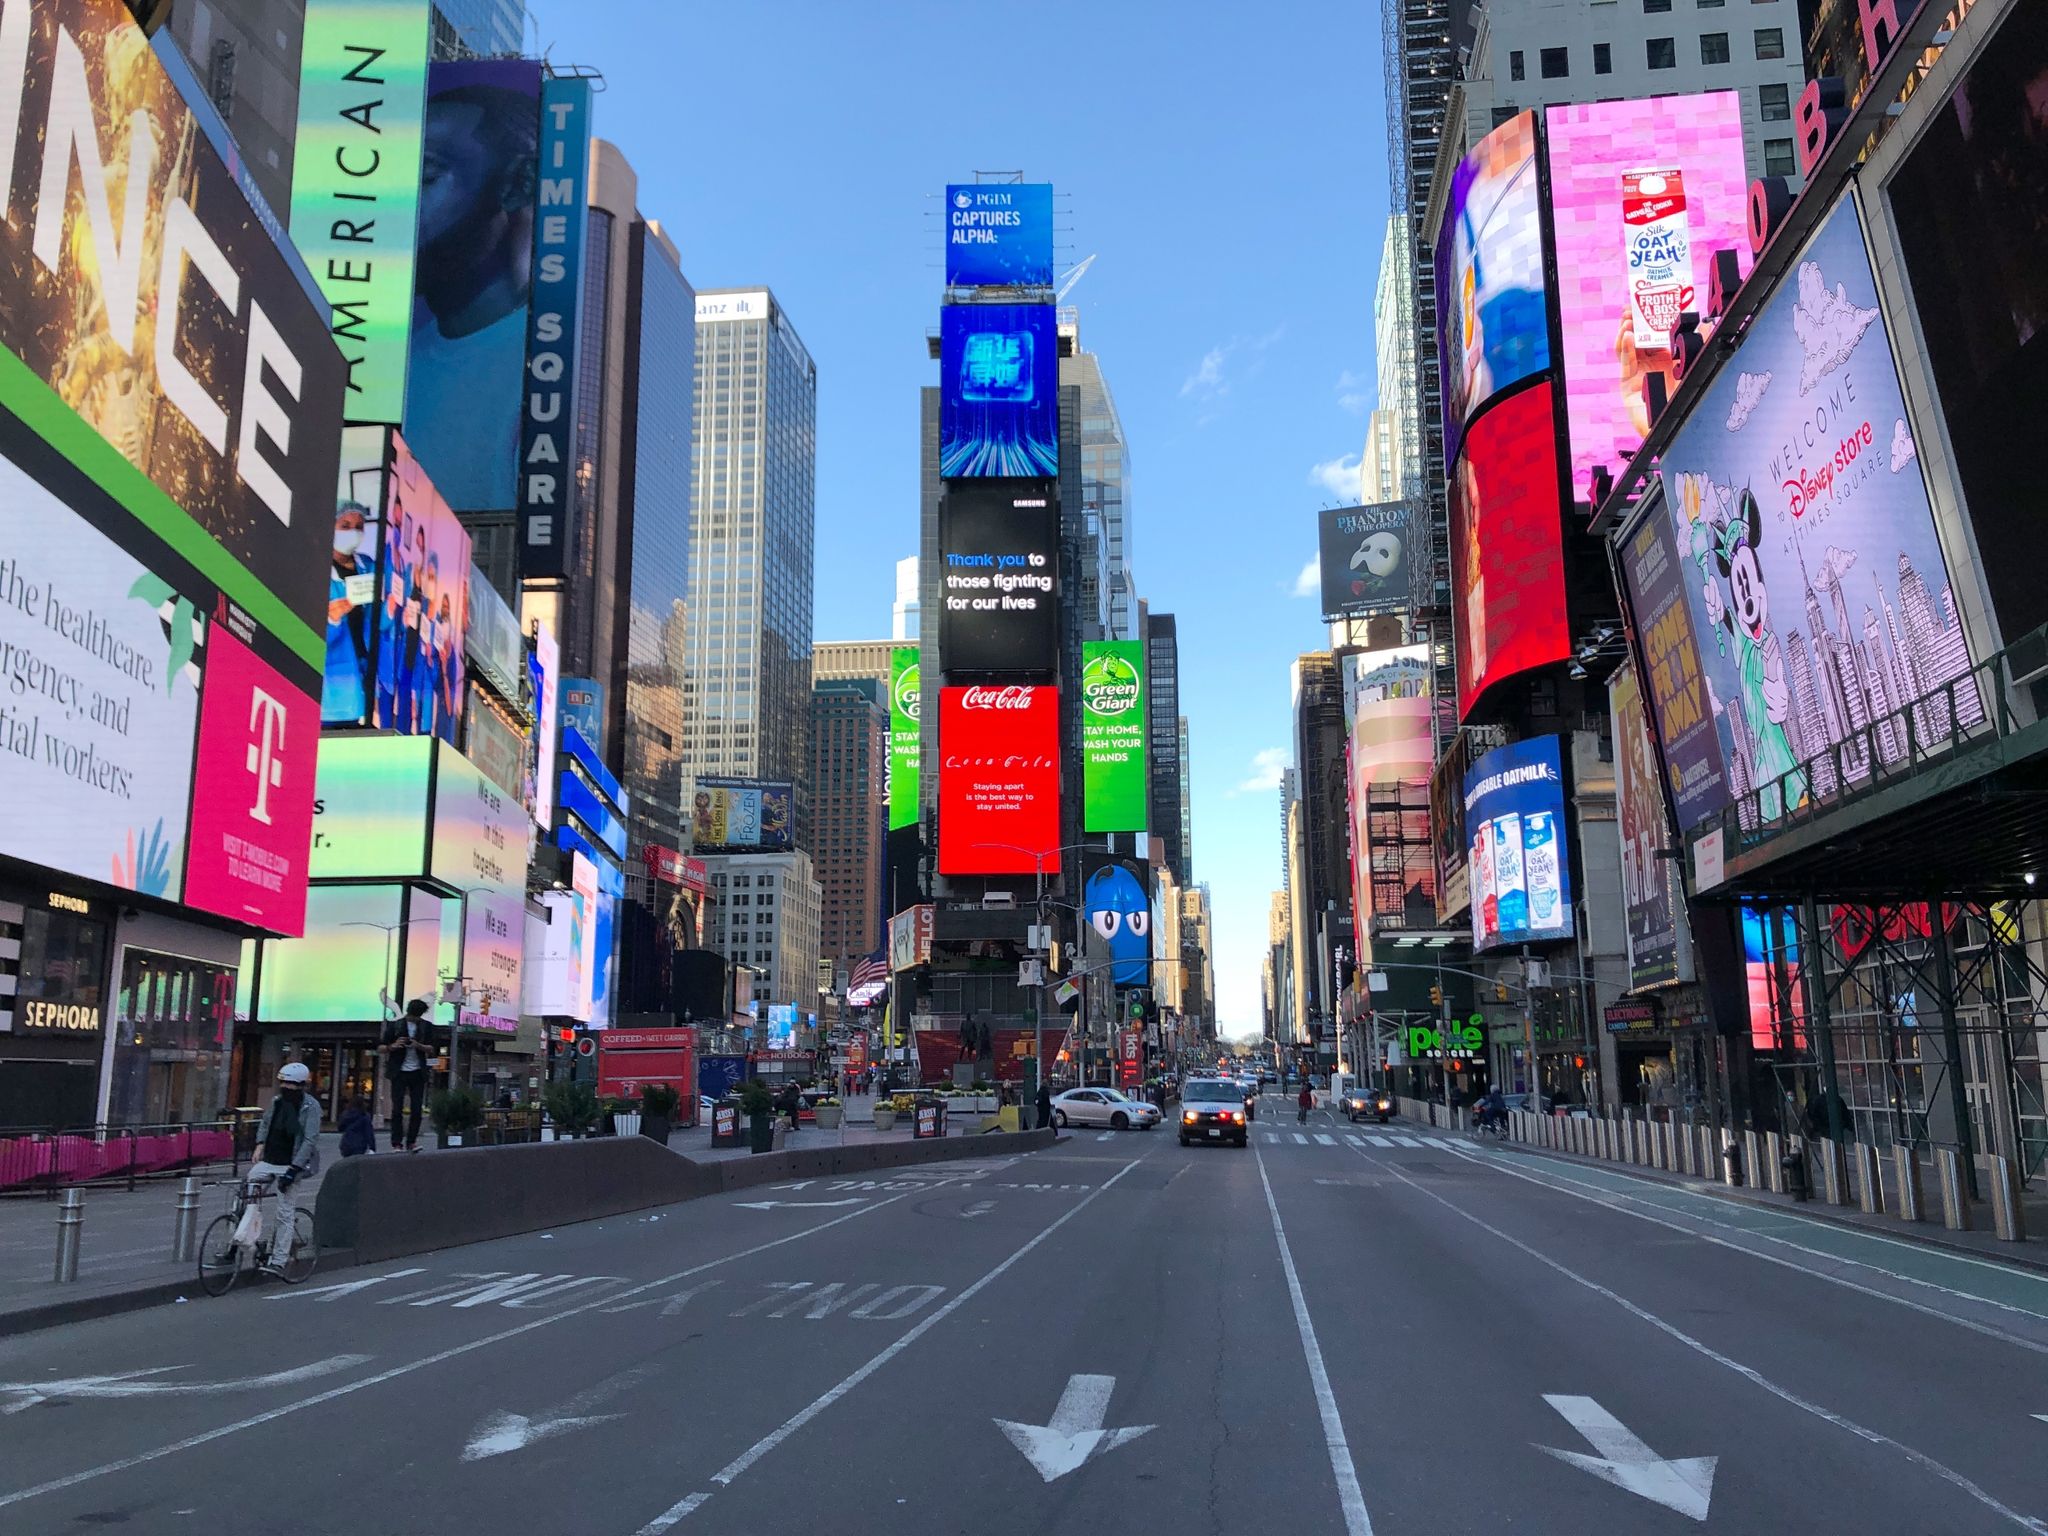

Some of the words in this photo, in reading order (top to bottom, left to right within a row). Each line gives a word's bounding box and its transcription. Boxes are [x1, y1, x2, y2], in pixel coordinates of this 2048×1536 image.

[539, 102, 579, 285] TIMES
[977, 193, 1012, 206] PGIM
[952, 210, 1021, 227] CAPTURES
[952, 228, 998, 244] ALPHA:
[1638, 229, 1674, 250] OAT
[1645, 225, 1667, 237] Silk
[1630, 245, 1682, 269] YEAH
[1639, 294, 1675, 306] FROTH
[1653, 303, 1681, 316] BOSS
[526, 313, 563, 546] SQUARE
[1768, 372, 1857, 484] WELCOME
[1777, 510, 1785, 527] TO
[1834, 420, 1874, 474] store
[1013, 499, 1047, 508] SAMSUNG
[1364, 507, 1381, 515] THE
[1783, 536, 1795, 557] AT
[1798, 502, 1832, 542] TIMES
[1836, 450, 1885, 505] SQUARE
[1337, 509, 1411, 529] PHANTOM
[1344, 526, 1355, 534] OF
[1358, 523, 1375, 532] THE
[1375, 521, 1405, 530] OPERA
[946, 553, 993, 566] Thank
[996, 554, 1025, 571] you
[1028, 553, 1046, 567] to
[946, 575, 990, 589] those
[993, 573, 1052, 592] fighting
[946, 596, 969, 610] for
[971, 597, 999, 610] our
[1001, 595, 1037, 610] lives
[0, 559, 39, 618] the
[43, 582, 156, 692] healthcare,
[1645, 598, 1690, 667] COME
[961, 685, 1036, 710] Coca-Cola
[1086, 682, 1136, 697] Green
[1092, 695, 1138, 711] Giant
[1664, 676, 1703, 746] AWAY
[90, 697, 130, 737] and
[1106, 725, 1142, 735] HOME,
[1111, 739, 1142, 748] YOUR
[1091, 752, 1129, 763] HANDS
[1503, 762, 1548, 787] OATMILK
[973, 783, 1002, 791] Staying
[1004, 783, 1025, 791] apart
[974, 793, 988, 801] the
[989, 793, 1006, 801] best
[1008, 794, 1023, 802] way
[740, 790, 756, 841] FROZEN
[976, 803, 993, 812] stay
[995, 802, 1021, 810] united.
[48, 892, 89, 915] SEPHORA
[920, 907, 934, 965] HELLO!
[25, 1001, 99, 1031] SEPHORA
